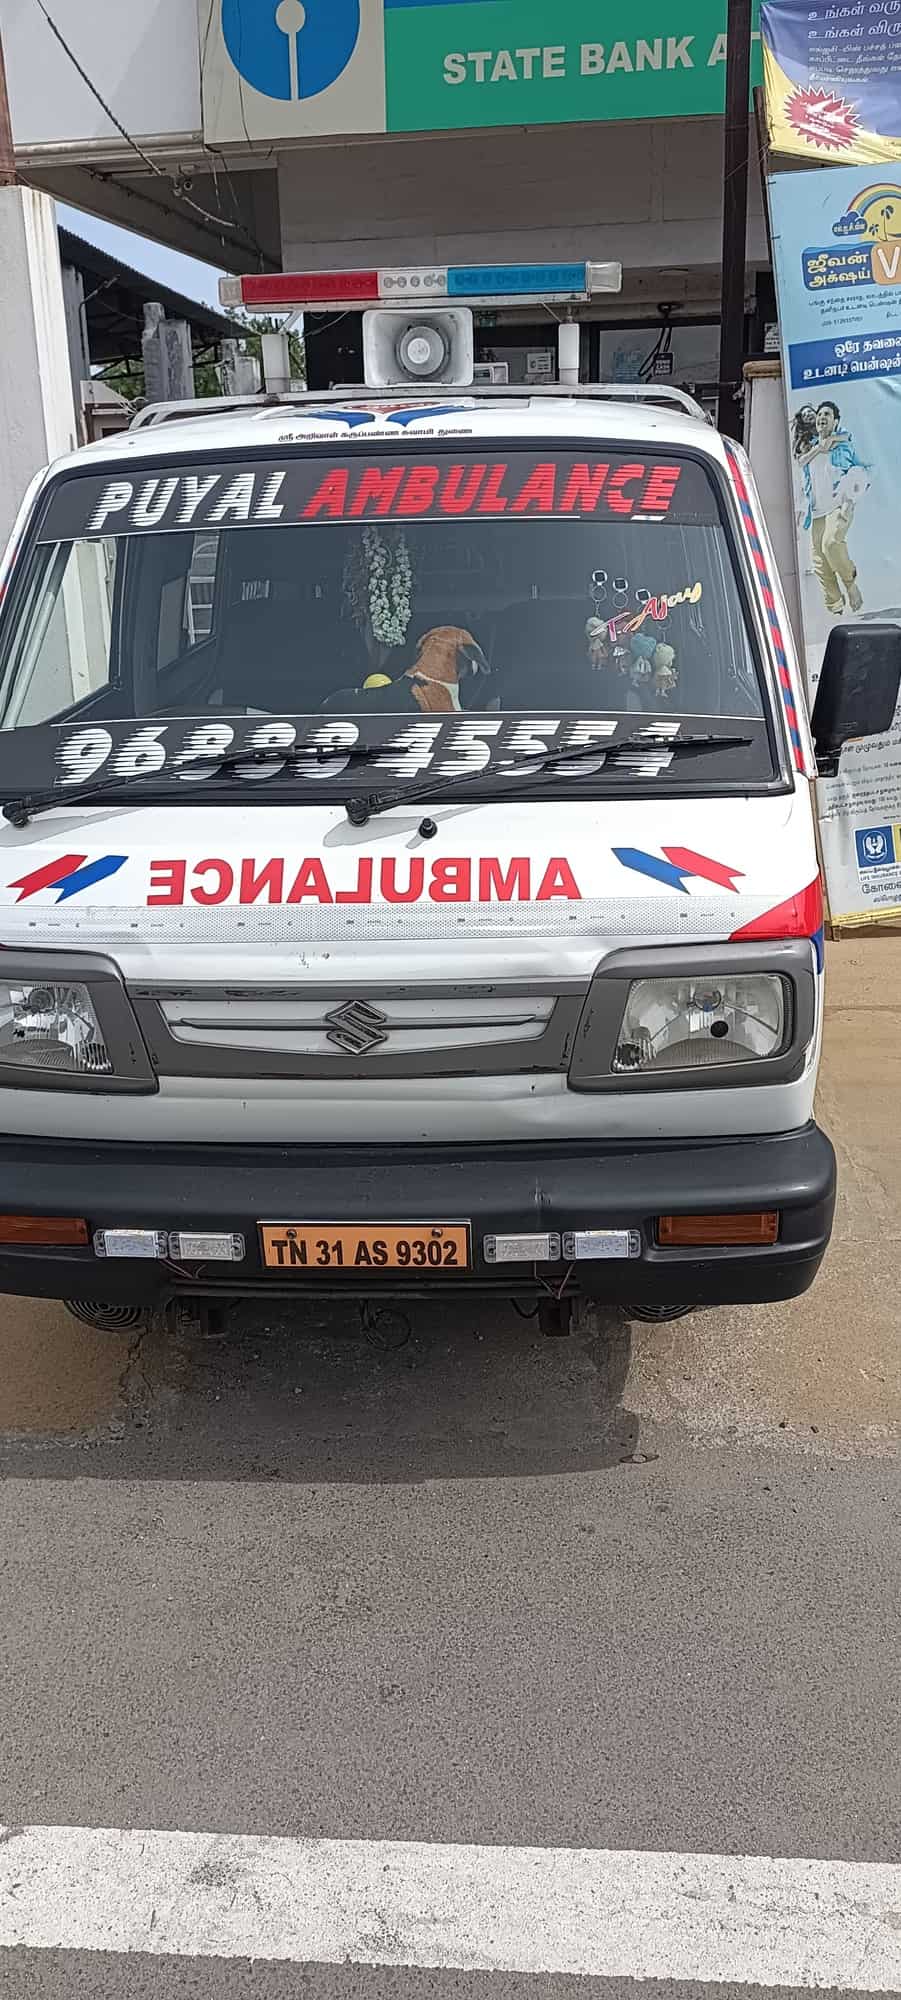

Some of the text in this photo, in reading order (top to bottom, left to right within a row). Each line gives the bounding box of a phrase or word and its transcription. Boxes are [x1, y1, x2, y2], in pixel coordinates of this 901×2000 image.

[808, 1, 865, 20] உங்கள்
[808, 23, 865, 39] உங்கள்
[443, 46, 566, 85] STATE
[580, 36, 695, 77] BANK
[807, 251, 869, 274] ஜீவன்
[834, 340, 860, 358] ஒரே
[803, 358, 849, 380] உடனடி
[85, 463, 681, 530] PUYAL AMBULANCE
[53, 720, 682, 787] 96888 45554
[271, 1239, 458, 1265] TN 31 AS 9302
